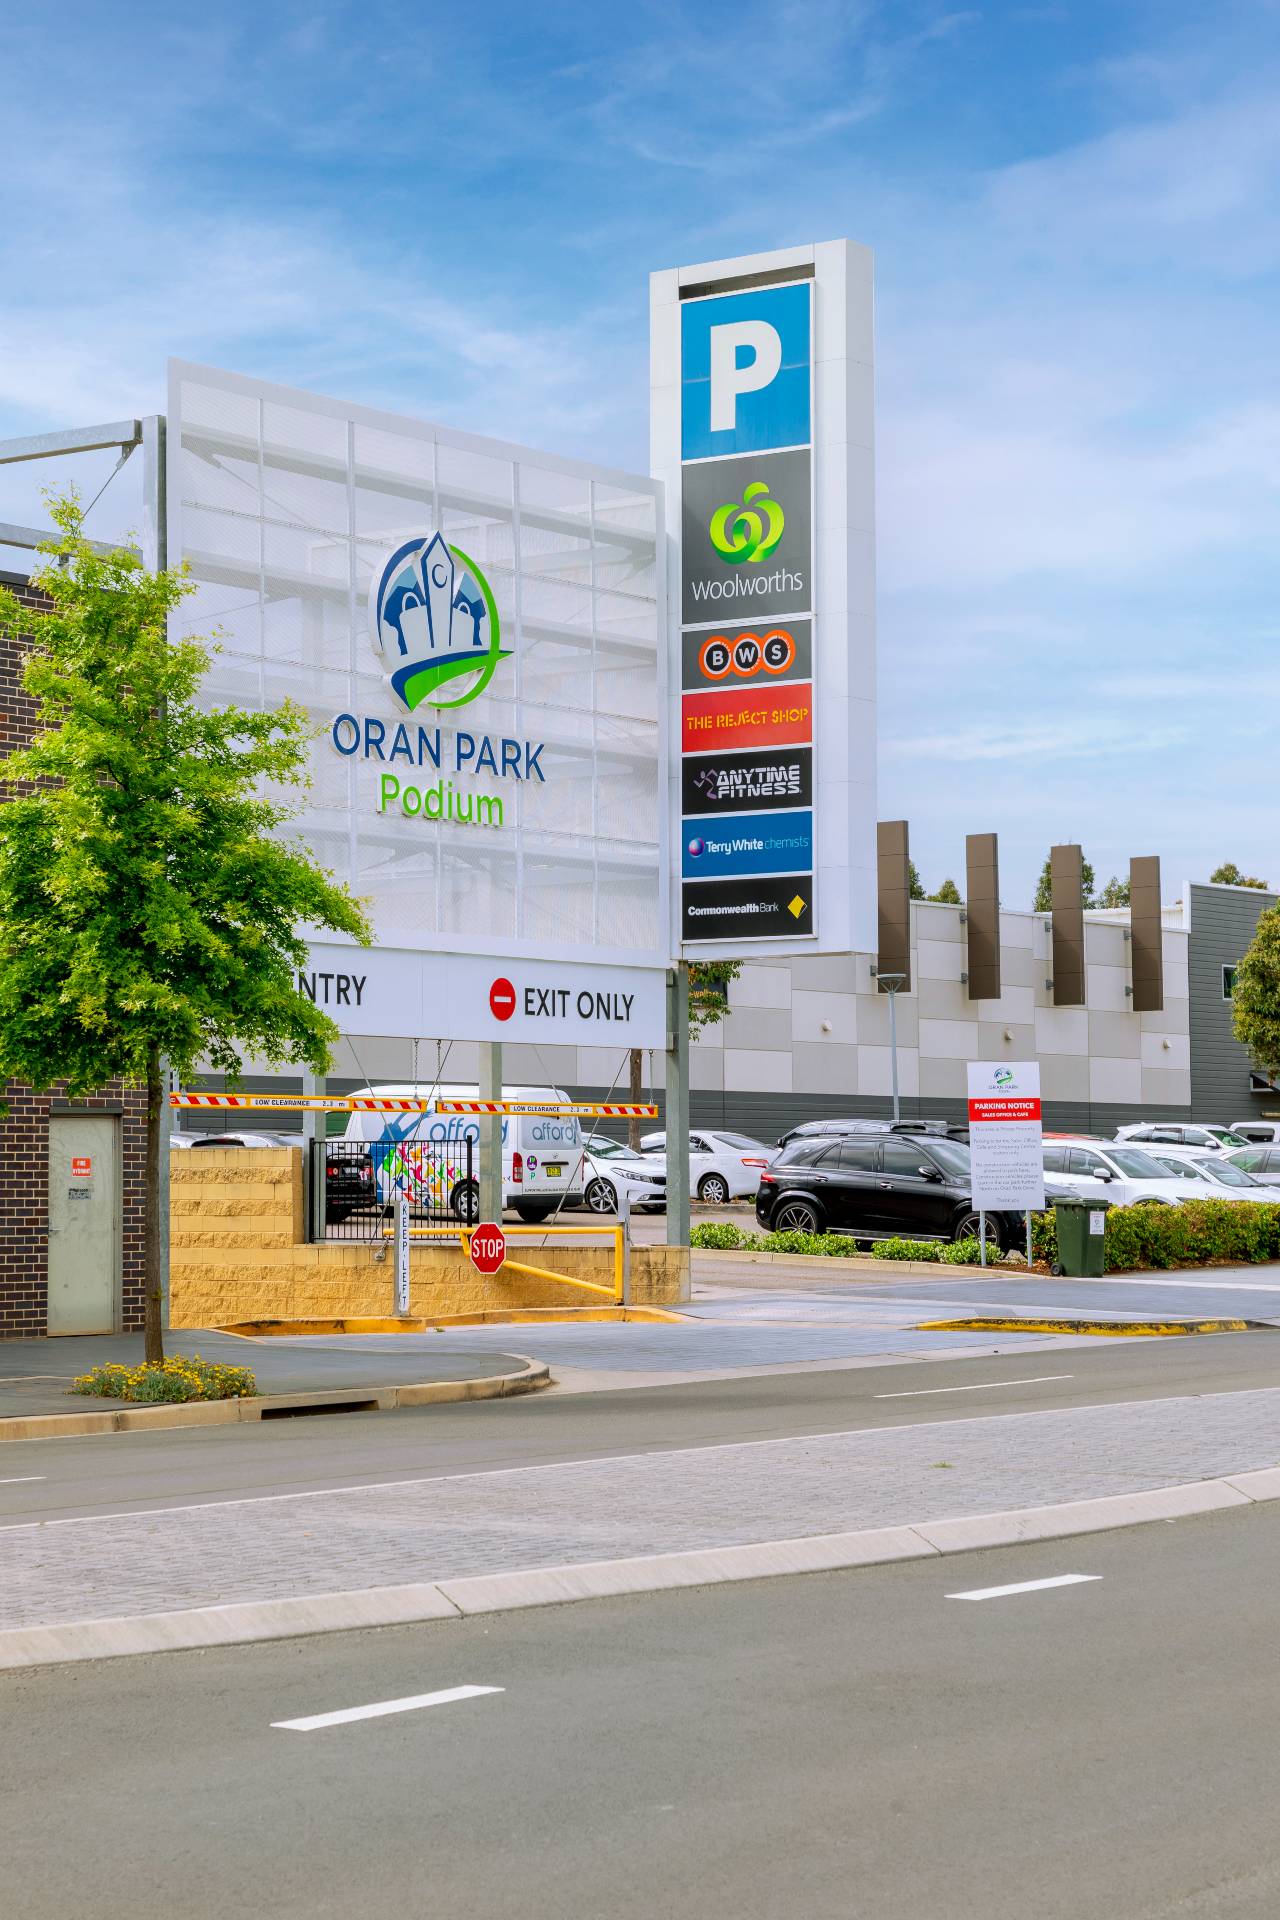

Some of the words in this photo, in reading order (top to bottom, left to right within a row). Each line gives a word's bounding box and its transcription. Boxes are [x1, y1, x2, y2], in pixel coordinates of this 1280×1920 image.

[710, 320, 782, 432] P
[691, 568, 803, 601] Woolworths
[712, 644, 782, 666] BWS
[686, 715, 713, 730] THE
[716, 710, 768, 728] REJECT
[771, 707, 809, 724] SHOP
[332, 713, 441, 769] ORAN
[456, 732, 545, 782] PARK
[716, 764, 800, 787] ANYTIME
[380, 773, 504, 826] Podium
[718, 780, 800, 799] FITNESS
[764, 835, 809, 850] chemists
[290, 971, 367, 1006] NTRY
[525, 987, 570, 1018] EXIT
[577, 991, 634, 1021] ONLY
[271, 1099, 310, 1107] CLEARANCE
[527, 1105, 560, 1113] CLEARANCE
[974, 1102, 1006, 1110] PARKING
[1007, 1102, 1035, 1110] NOTICE
[472, 1238, 504, 1258] STOP
